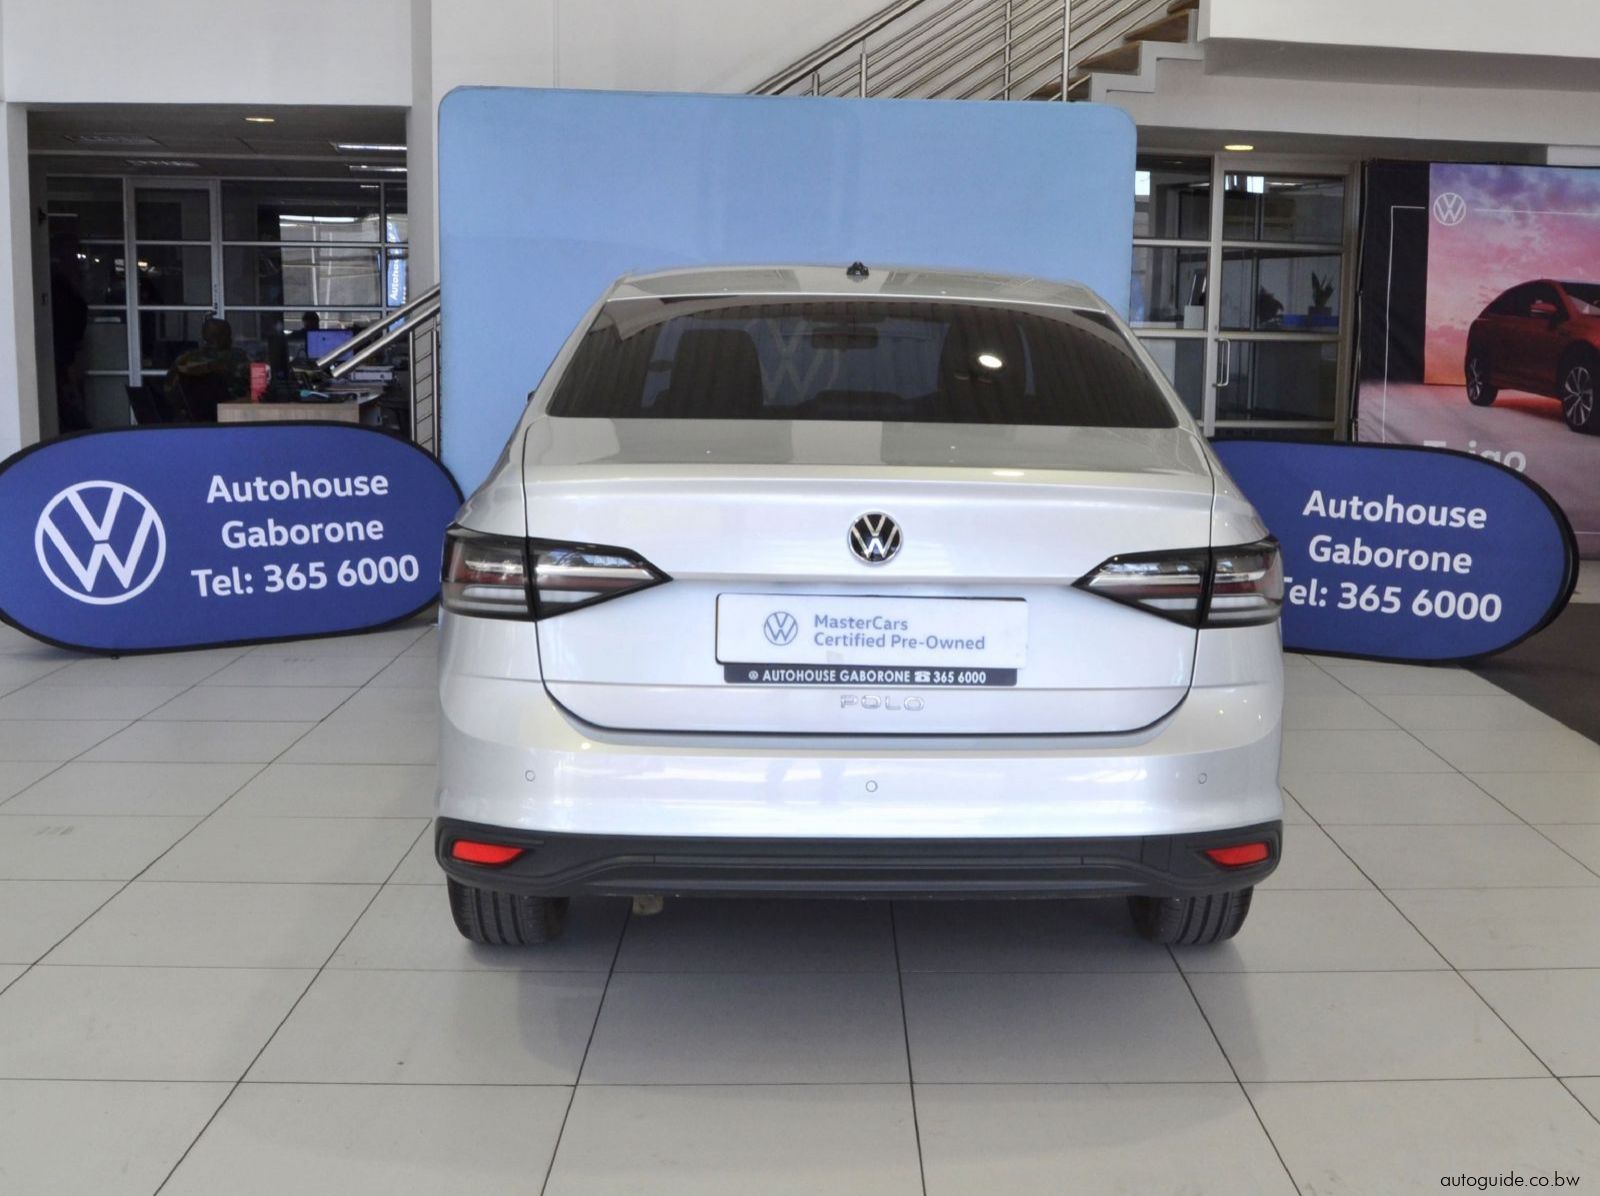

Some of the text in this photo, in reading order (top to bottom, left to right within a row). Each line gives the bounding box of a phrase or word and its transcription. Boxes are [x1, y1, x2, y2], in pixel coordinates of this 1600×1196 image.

[207, 471, 389, 504] Autohouse
[1303, 490, 1488, 530] Autohouse
[34, 480, 166, 605] VW
[221, 519, 384, 549] Gaborone
[849, 511, 902, 563] VW
[1309, 534, 1473, 574] Gaborone
[191, 555, 419, 597] Tel: 365 6000
[1337, 582, 1402, 614] 365
[1411, 588, 1502, 623] 6000
[814, 614, 908, 631] MasterCars
[813, 632, 986, 651] Certified Pre-Owned
[762, 669, 836, 682] AUTOHOUSE
[840, 669, 911, 683] GABORONE
[933, 671, 955, 684] 365
[958, 671, 986, 685] 6000
[840, 694, 925, 711] POLO
